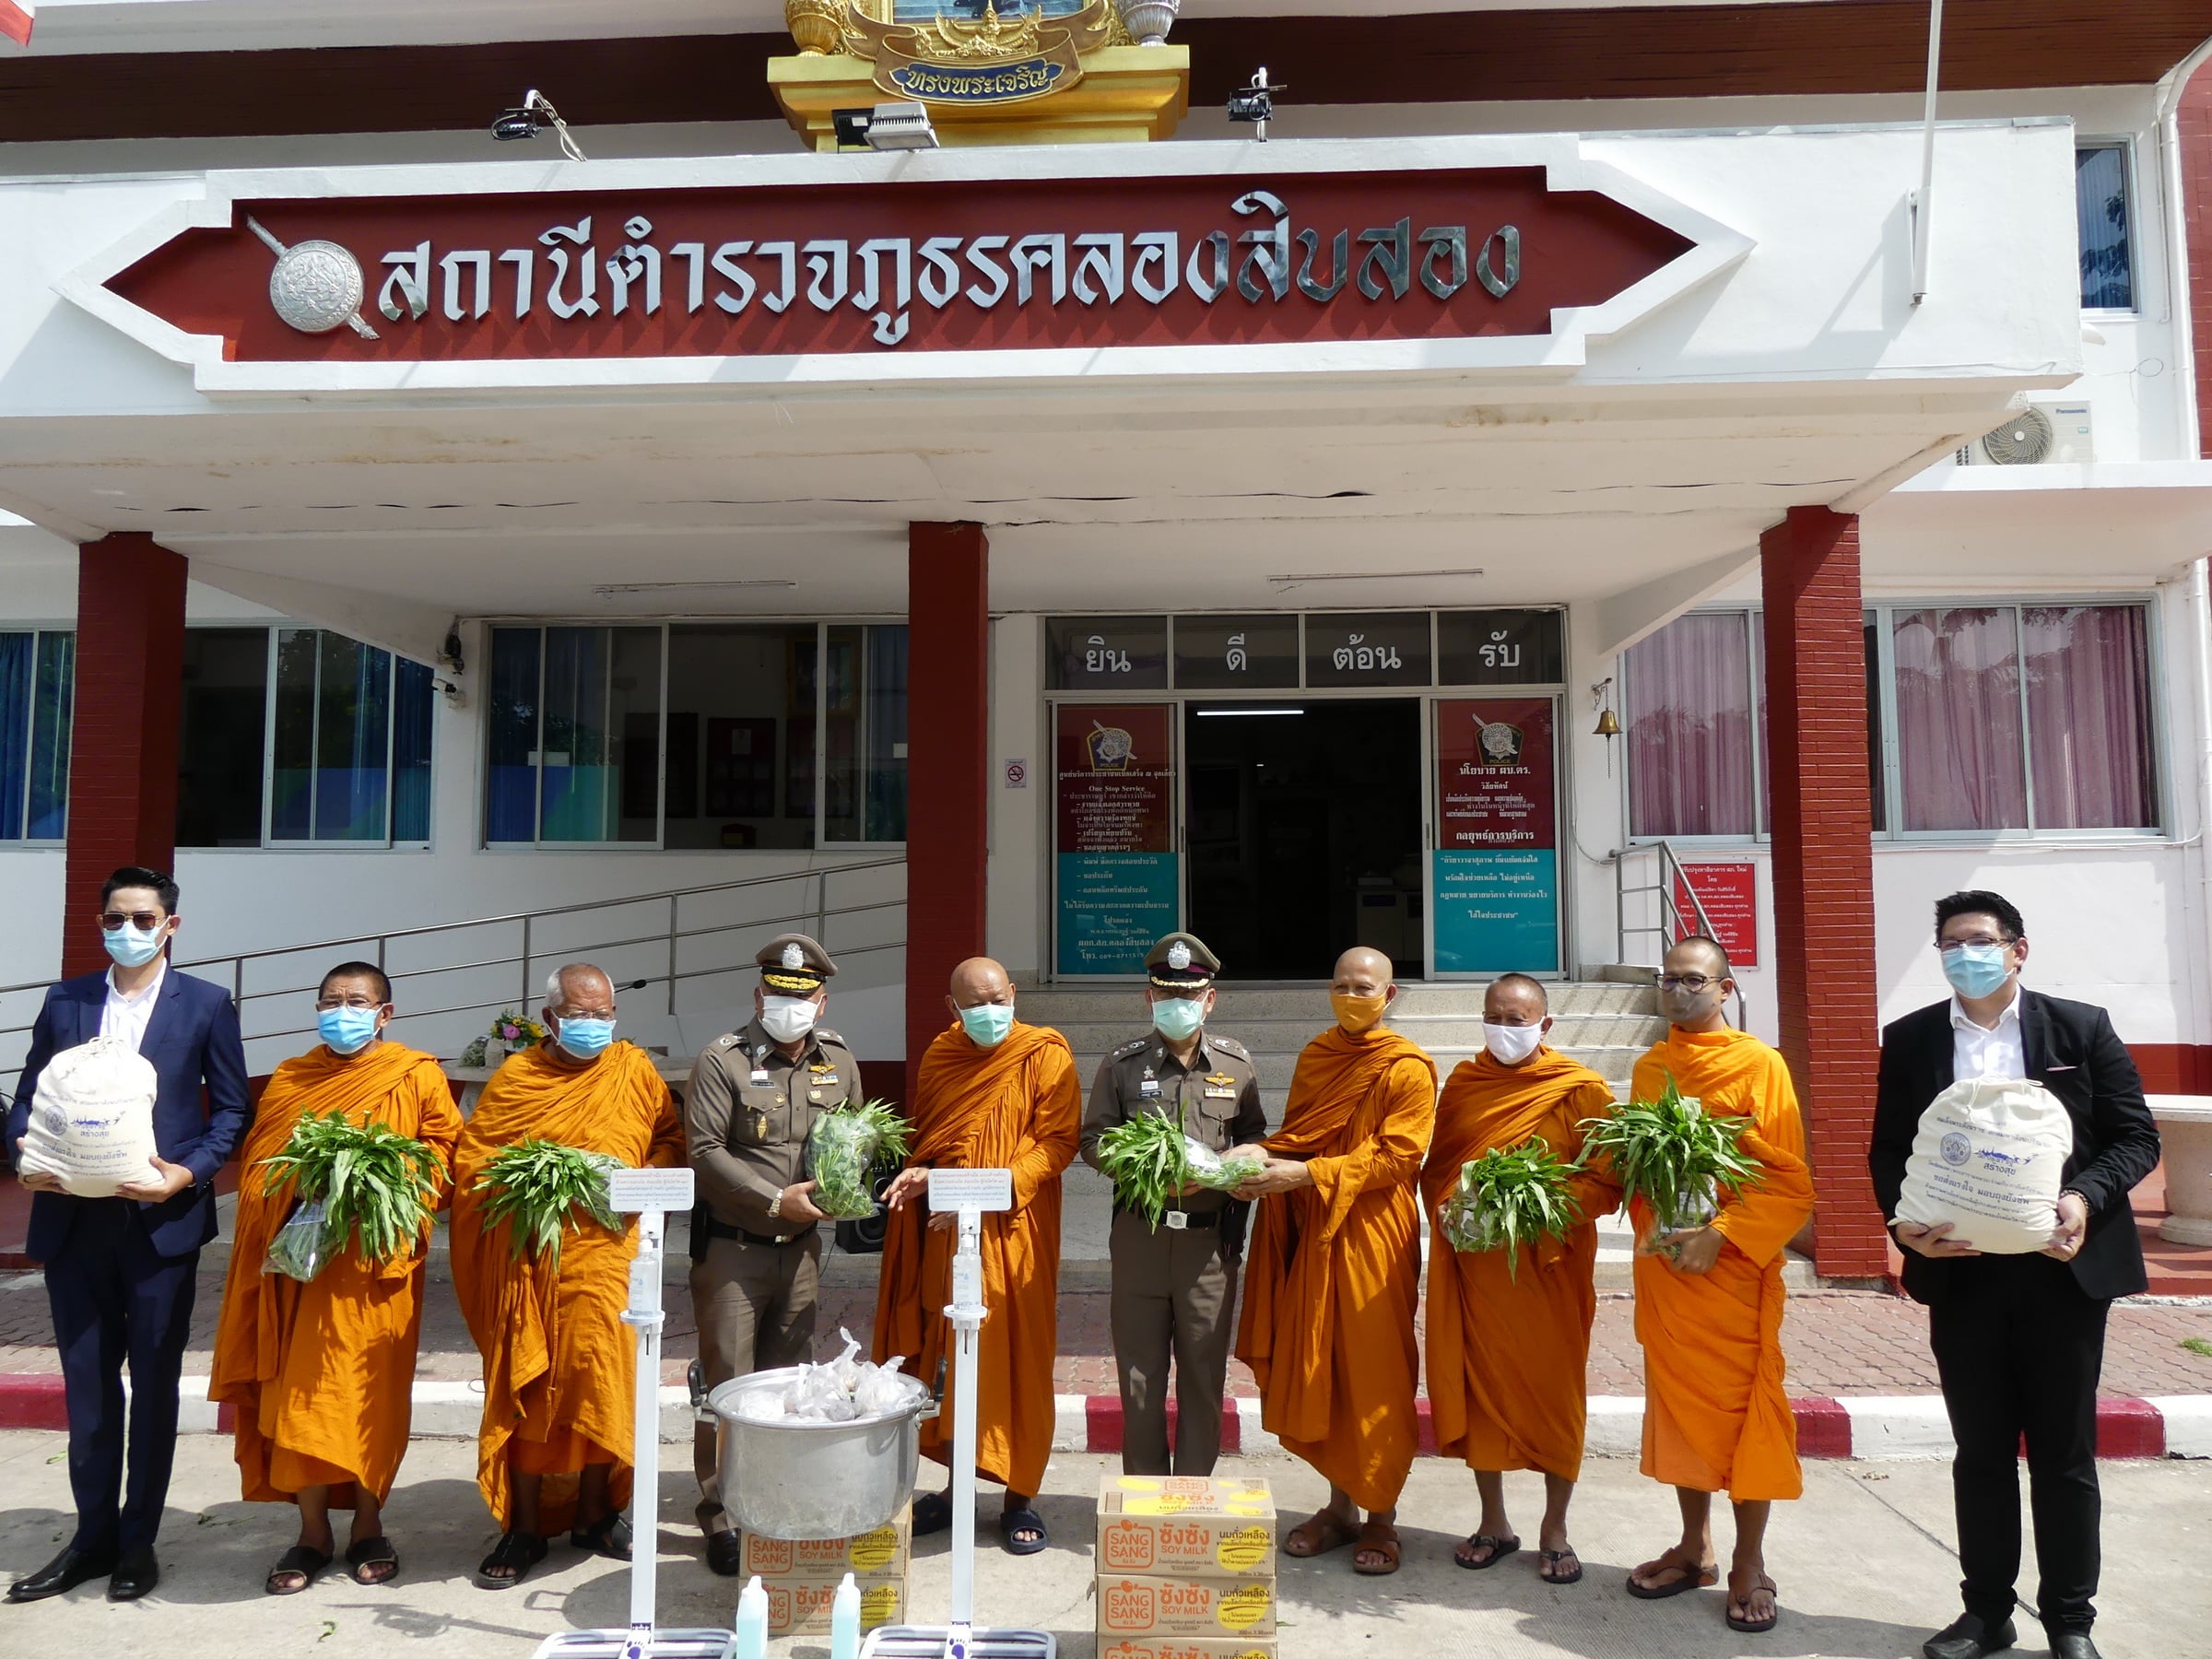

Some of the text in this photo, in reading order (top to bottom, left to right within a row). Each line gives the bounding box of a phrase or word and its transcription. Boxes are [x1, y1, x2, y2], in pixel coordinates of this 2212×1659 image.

[906, 65, 1048, 96] ทรงพระเจริญ
[379, 189, 1521, 346] สถานีตำรวจภูธรคลองสิบสอง
[1225, 633, 1247, 672] ดี
[1331, 634, 1402, 671] ต้อน
[1478, 629, 1521, 668] รับ
[1104, 785, 1120, 794] Stop
[1983, 1161, 2017, 1178] สร้างสุข
[1219, 1526, 1270, 1539] นมถั่วเหลือง
[1111, 1533, 1149, 1546] SANG
[752, 1541, 788, 1552] SANG
[1111, 1546, 1149, 1558] SANG
[1161, 1545, 1208, 1555] SOY MILK
[752, 1553, 788, 1563] SANG
[1219, 1584, 1270, 1597] นมถั่วเหลือง
[769, 1596, 786, 1607] NG
[1111, 1594, 1149, 1606] SANG
[769, 1607, 786, 1618] NG
[1111, 1607, 1149, 1619] SANG
[1161, 1606, 1208, 1615] SOY MILK
